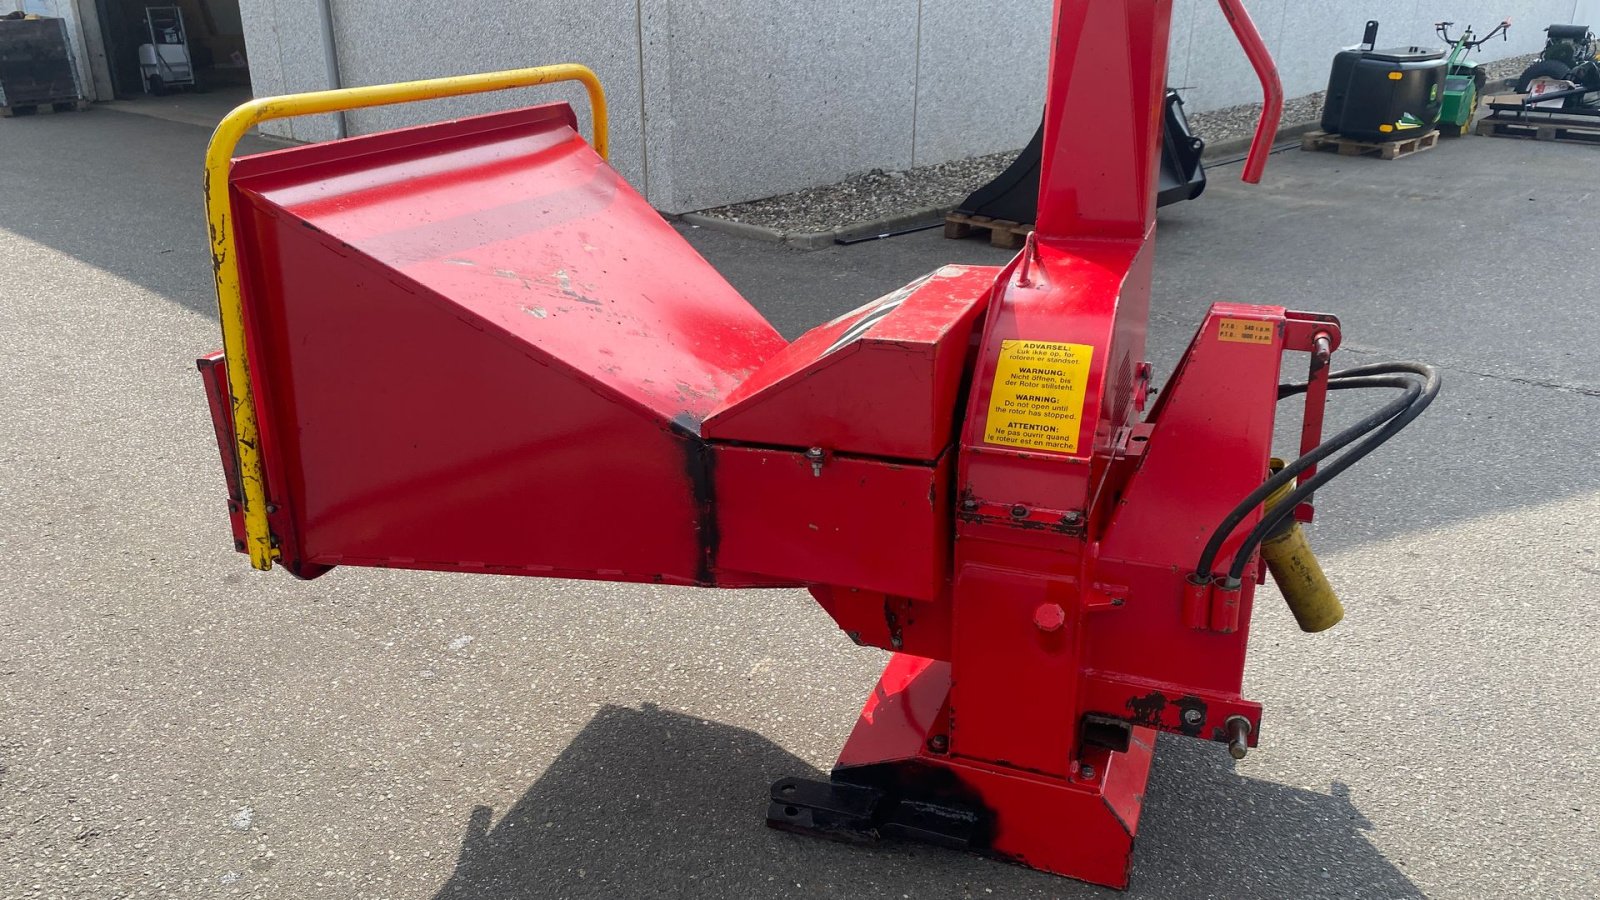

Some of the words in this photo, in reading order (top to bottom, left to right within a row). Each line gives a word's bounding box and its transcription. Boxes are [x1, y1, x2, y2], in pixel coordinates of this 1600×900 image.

[1019, 367, 1066, 376] WARNUNG:
[1016, 394, 1059, 404] WARNING:
[1044, 412, 1076, 420] stopped.
[1008, 422, 1058, 432] ATTENTION:
[1046, 433, 1069, 441] quand
[1046, 441, 1075, 449] marche.
